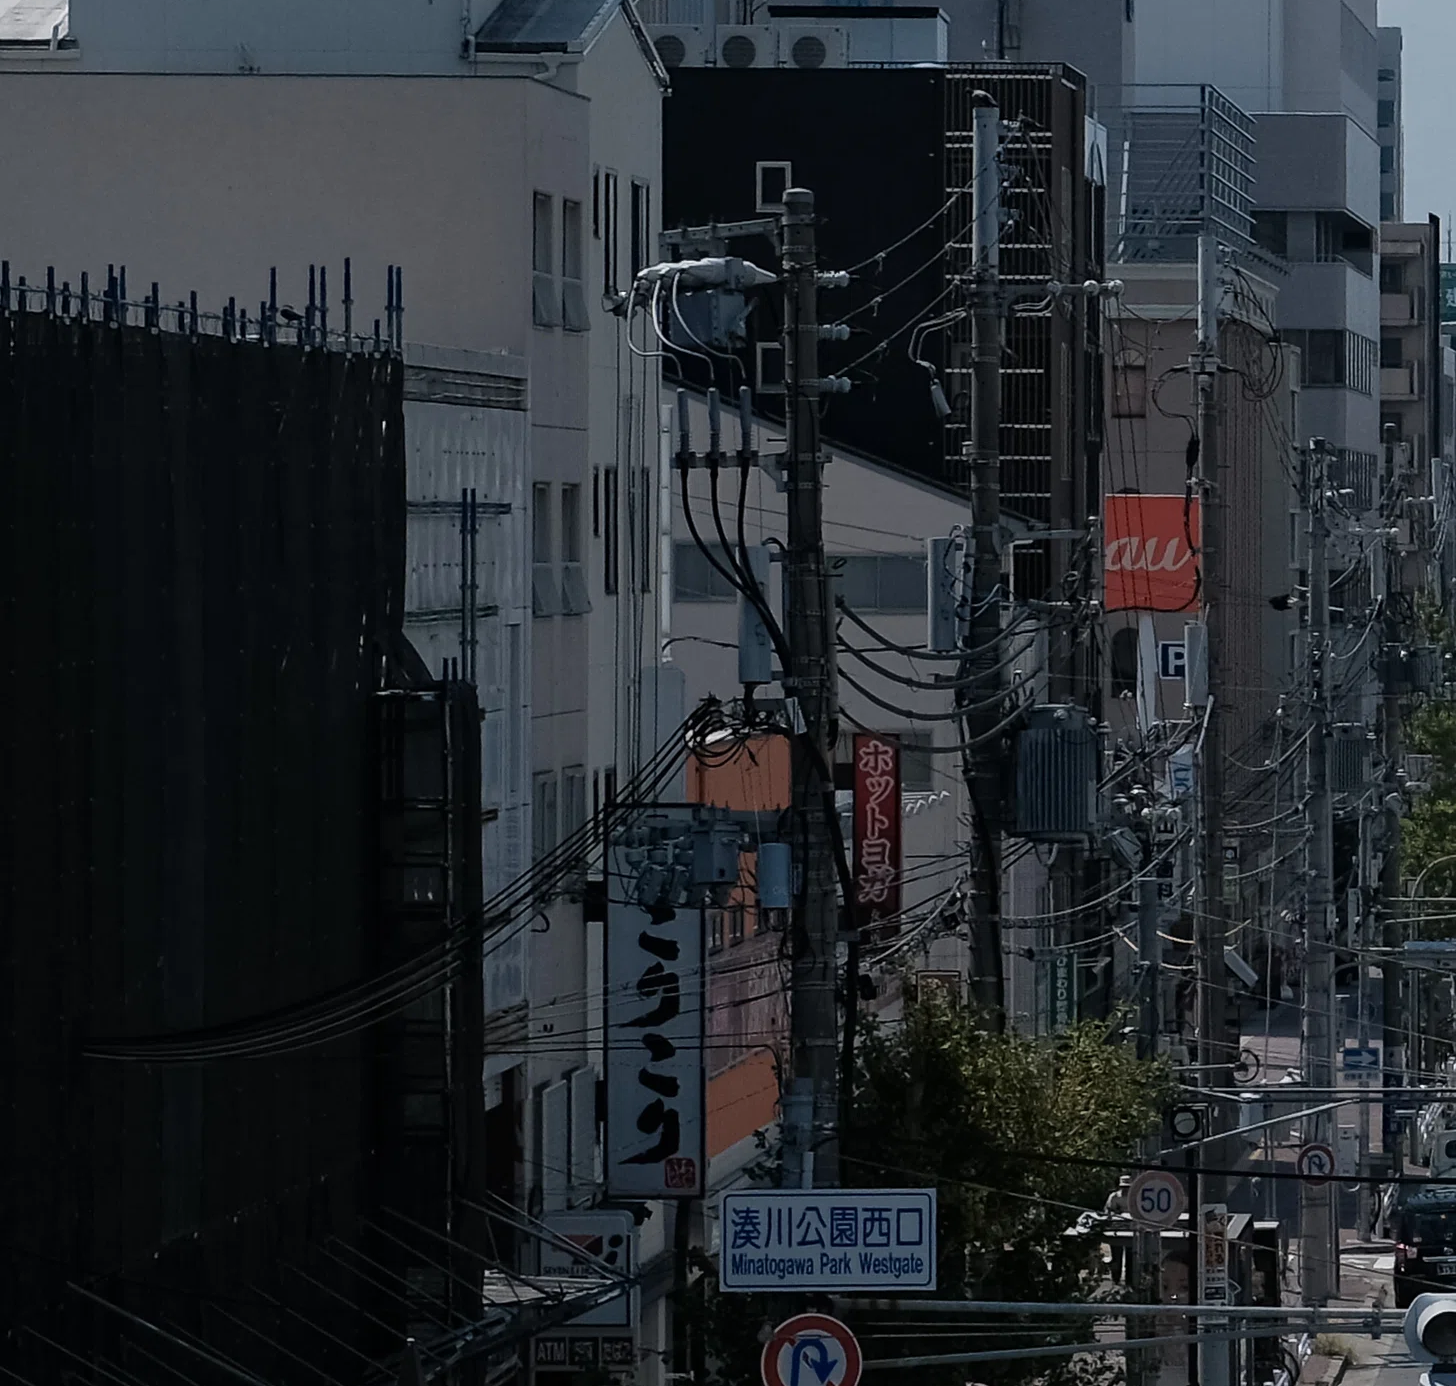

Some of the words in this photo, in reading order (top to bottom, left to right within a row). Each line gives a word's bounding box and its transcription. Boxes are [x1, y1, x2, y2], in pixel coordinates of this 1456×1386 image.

[1104, 535, 1195, 573] au
[857, 739, 895, 903] ホットヨガ
[1141, 1187, 1171, 1213] 50
[731, 1206, 923, 1250] 湊川公園西口
[731, 1252, 814, 1280] Minatogawa
[819, 1252, 852, 1276] Park
[858, 1252, 924, 1280] Westgate
[537, 1340, 565, 1363] ATM
